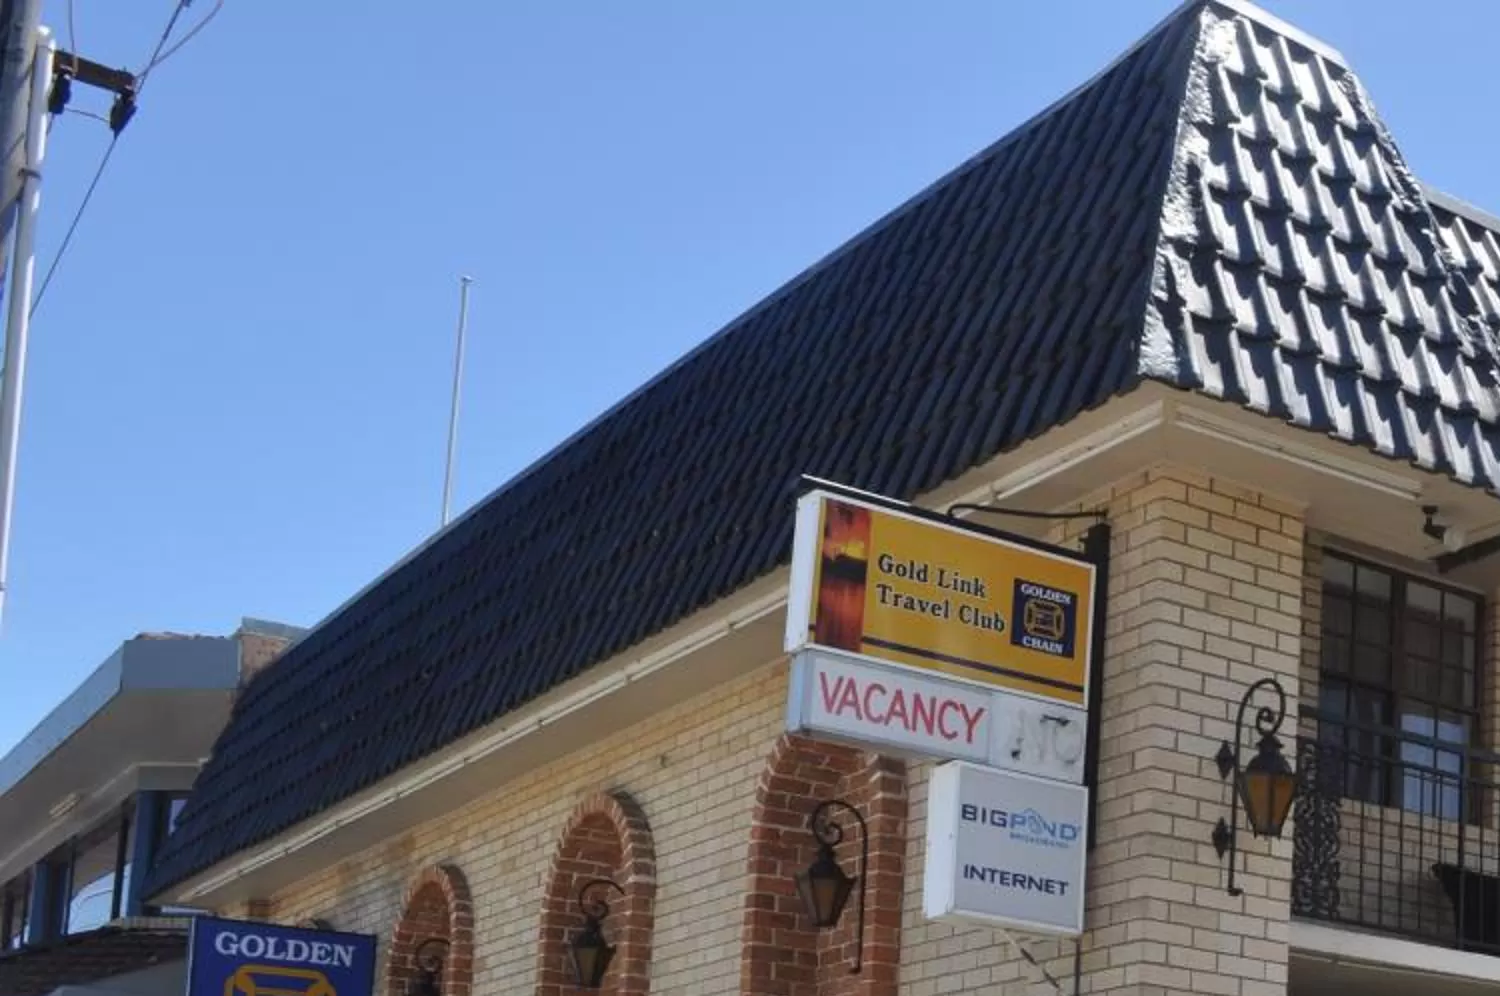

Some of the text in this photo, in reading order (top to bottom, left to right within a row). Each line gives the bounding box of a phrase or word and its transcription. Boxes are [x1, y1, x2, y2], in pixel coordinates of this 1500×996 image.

[877, 553, 986, 598] Gold Link
[876, 583, 1006, 633] Travel Club
[1020, 583, 1072, 605] GOLDEN
[1022, 635, 1064, 654] CHAIN
[819, 671, 985, 744] VACANCY
[963, 863, 1069, 896] INTERNET
[215, 931, 355, 967] GOLDEN
